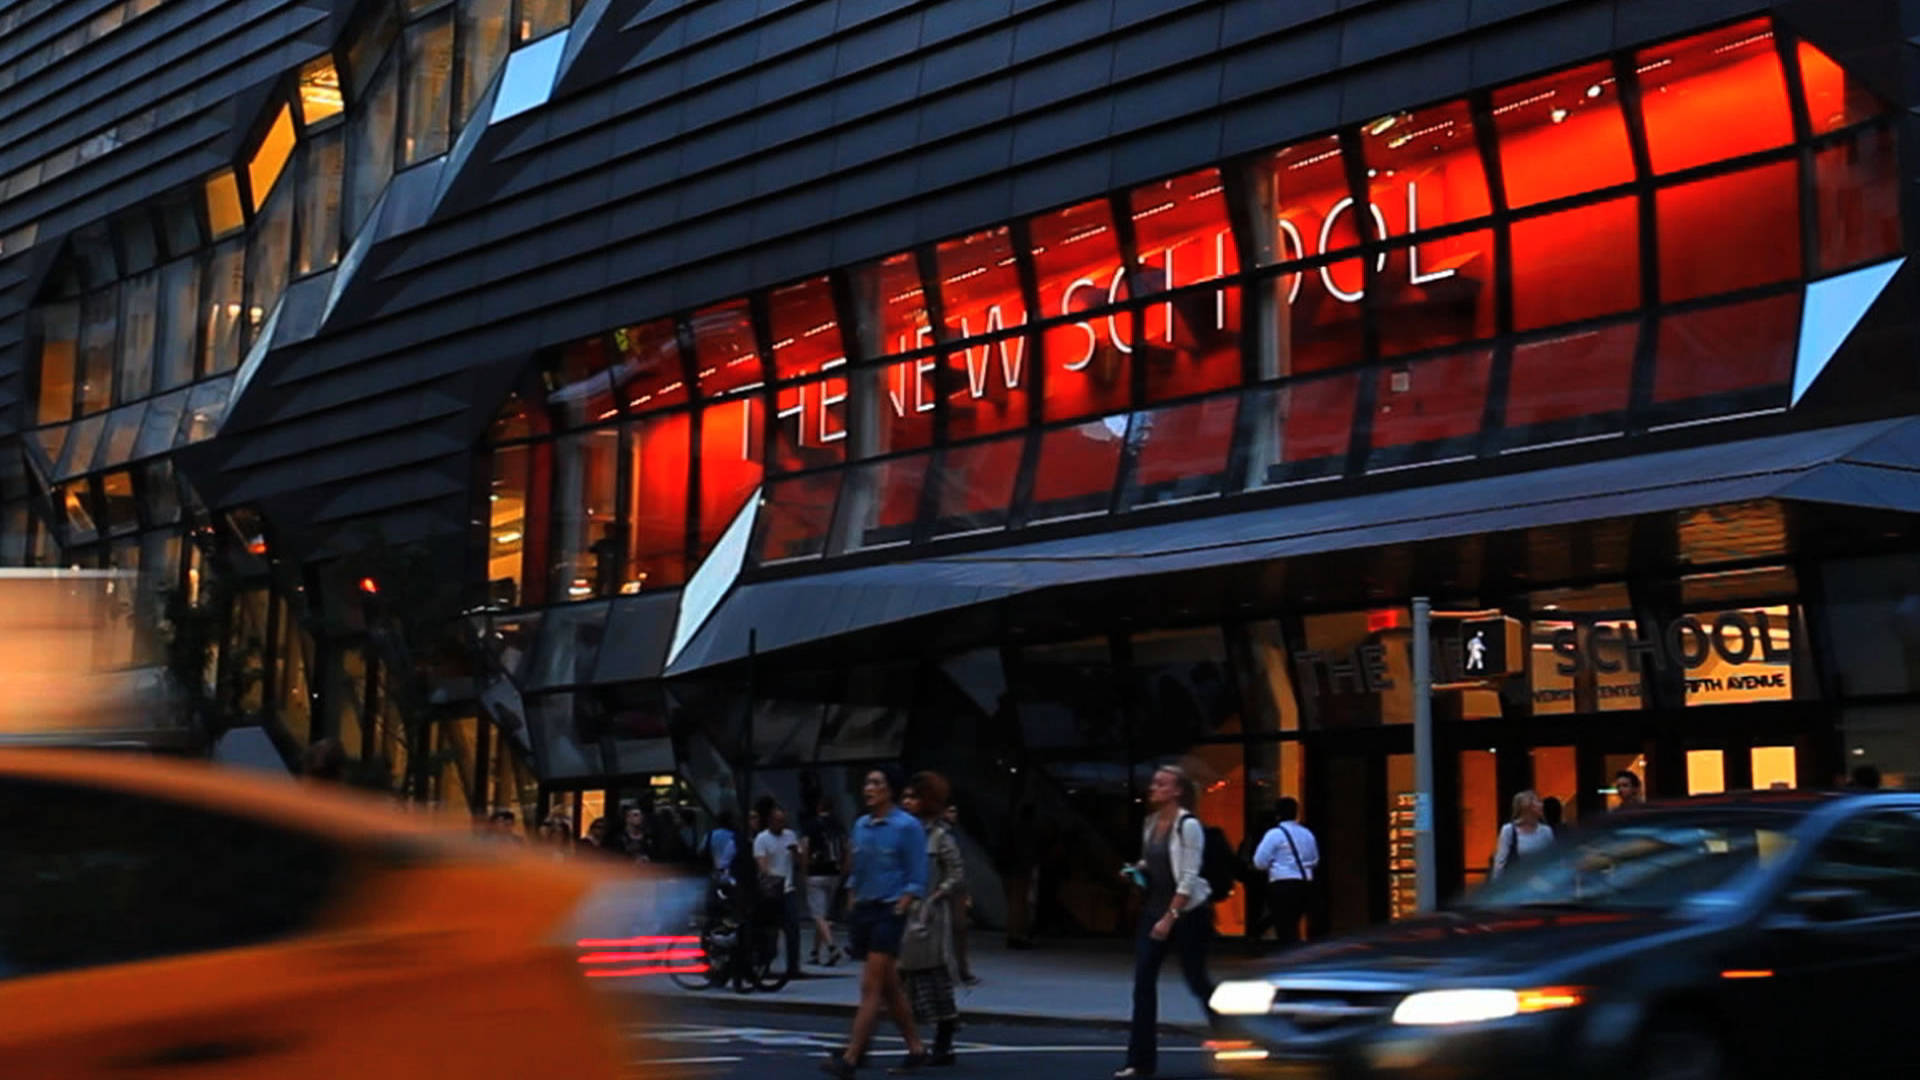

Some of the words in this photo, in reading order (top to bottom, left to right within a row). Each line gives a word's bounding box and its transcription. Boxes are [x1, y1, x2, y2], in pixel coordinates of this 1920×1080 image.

[726, 357, 848, 461] THE
[1063, 181, 1456, 371] SCHOOL
[1293, 645, 1396, 696] THE
[1553, 610, 1792, 676] SCHOOL
[1727, 673, 1787, 690] AVENUE
